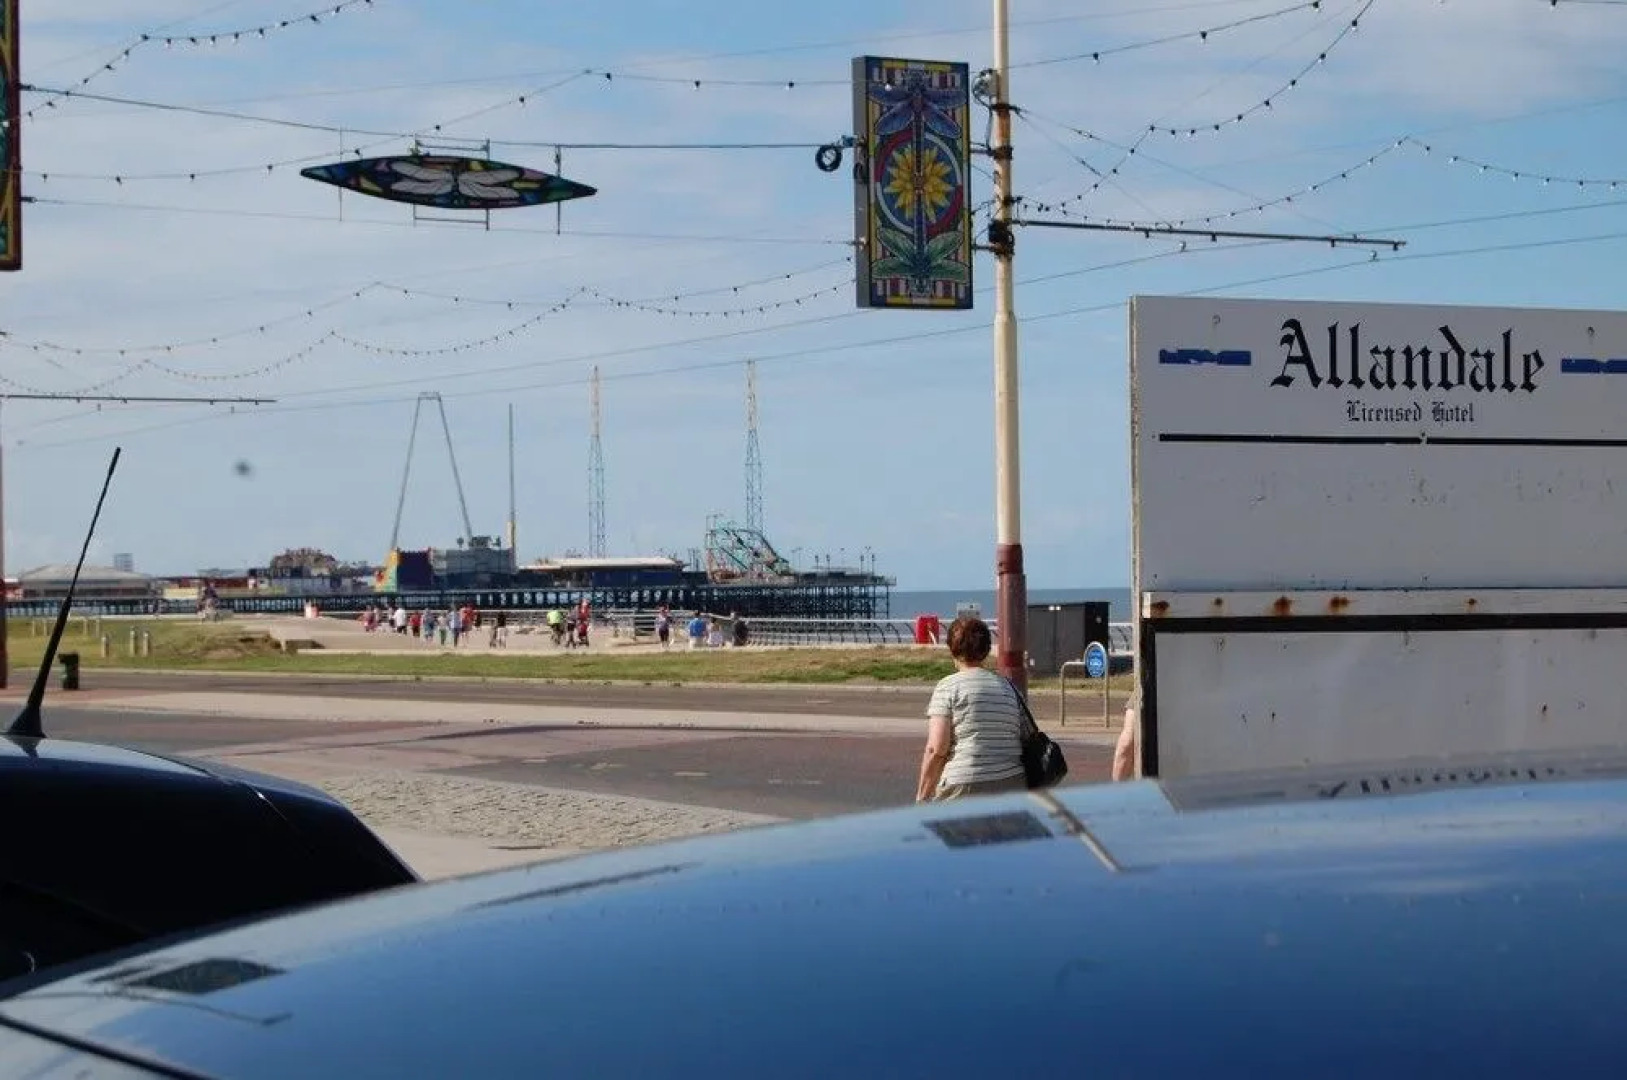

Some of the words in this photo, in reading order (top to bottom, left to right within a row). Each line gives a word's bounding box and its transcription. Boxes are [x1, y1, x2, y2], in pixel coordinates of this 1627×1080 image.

[1270, 318, 1545, 393] Allandale
[1346, 400, 1423, 423] Licensed
[1431, 401, 1475, 426] Hotel
